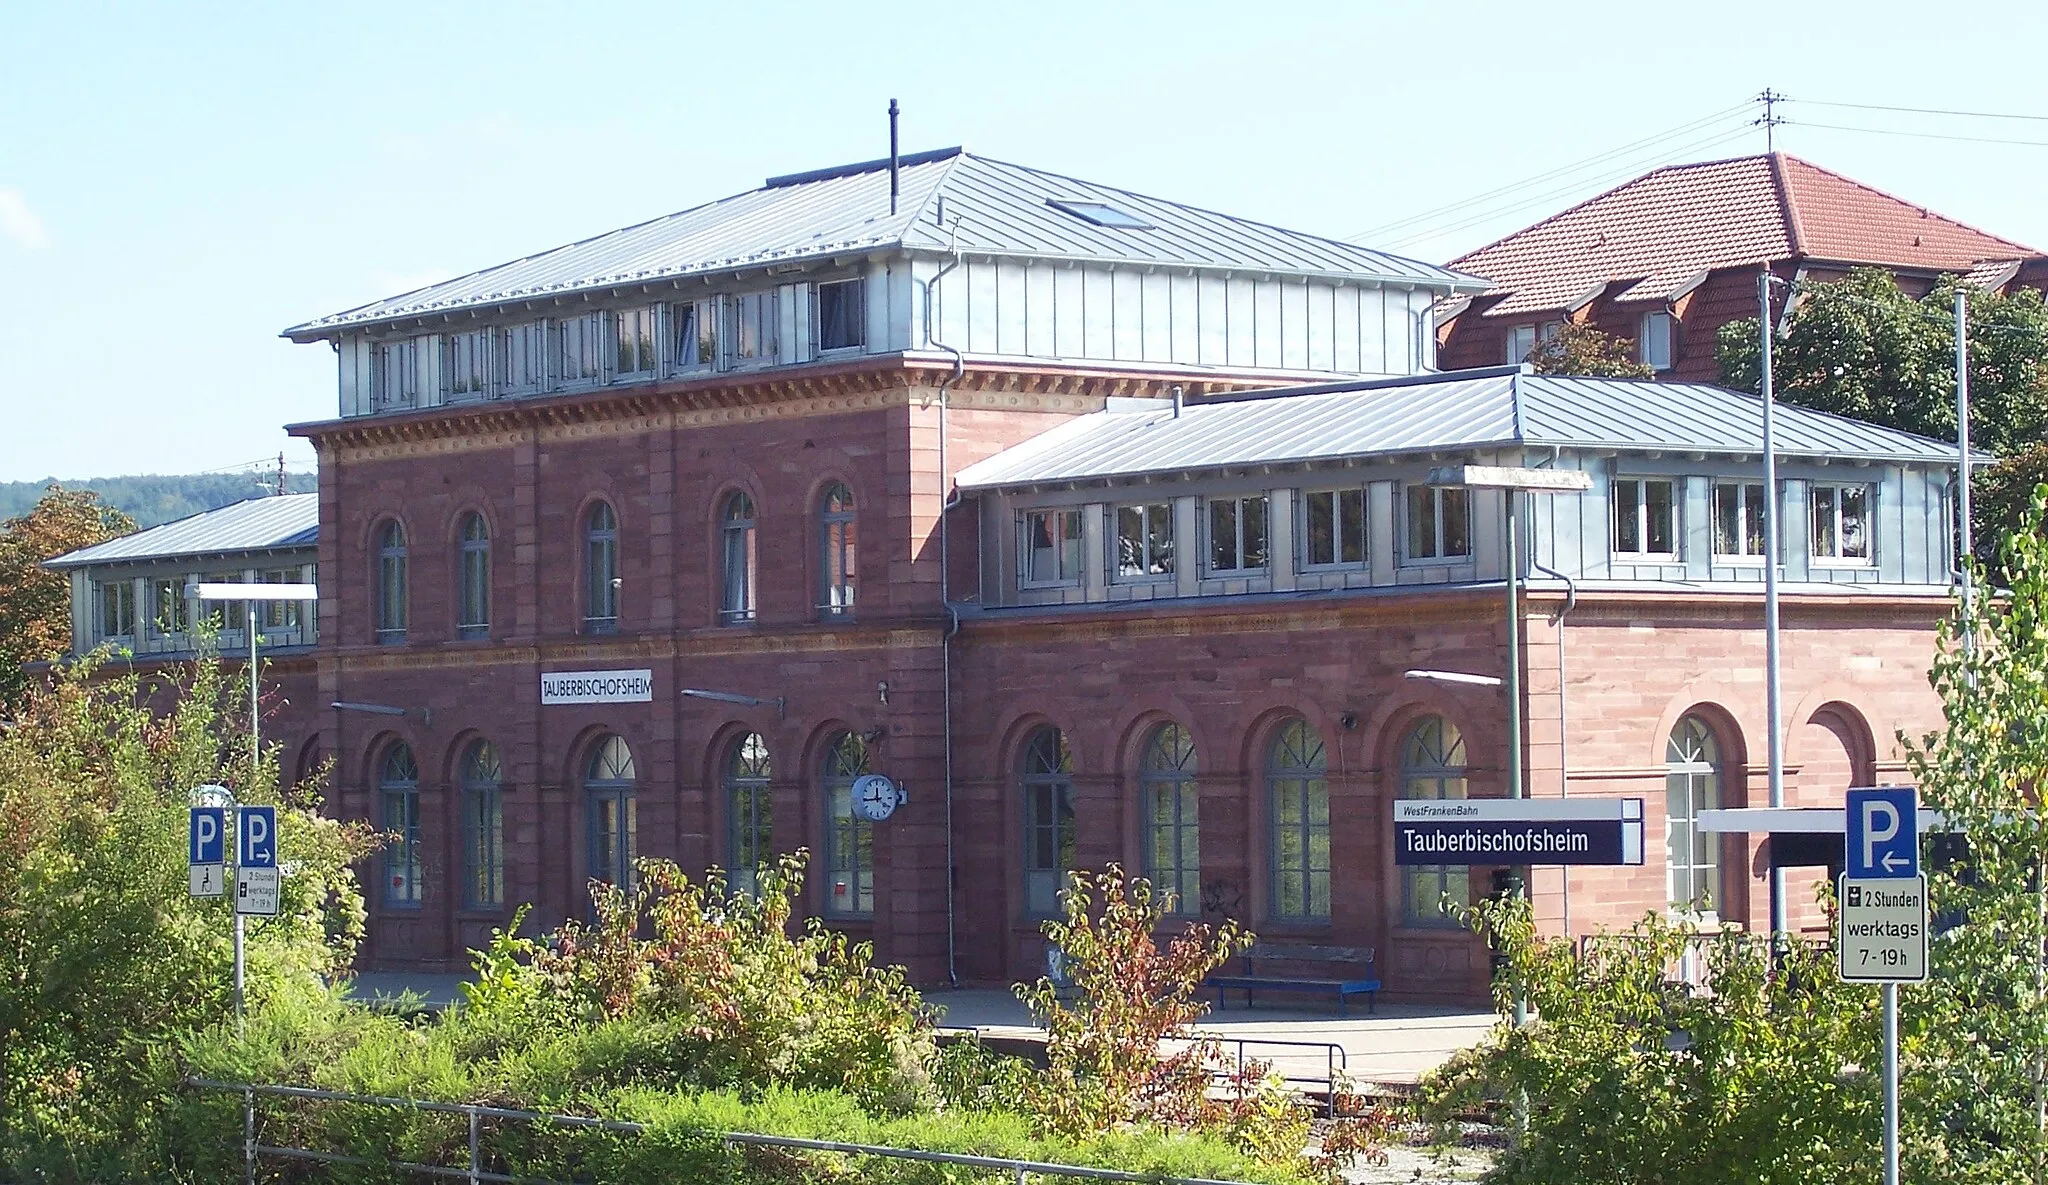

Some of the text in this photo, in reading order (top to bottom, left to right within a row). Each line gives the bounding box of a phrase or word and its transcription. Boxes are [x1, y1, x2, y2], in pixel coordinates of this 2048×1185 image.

[543, 678, 653, 697] TAUBERBISCHOFSHEIM
[1403, 805, 1479, 817] WestFrankenBahn
[197, 814, 217, 861] P
[248, 814, 268, 861] P
[1403, 828, 1589, 852] Tauberbischofsheim
[1862, 800, 1900, 869] P
[1865, 890, 1919, 908] 2 Stunden
[1847, 920, 1919, 940] werktags
